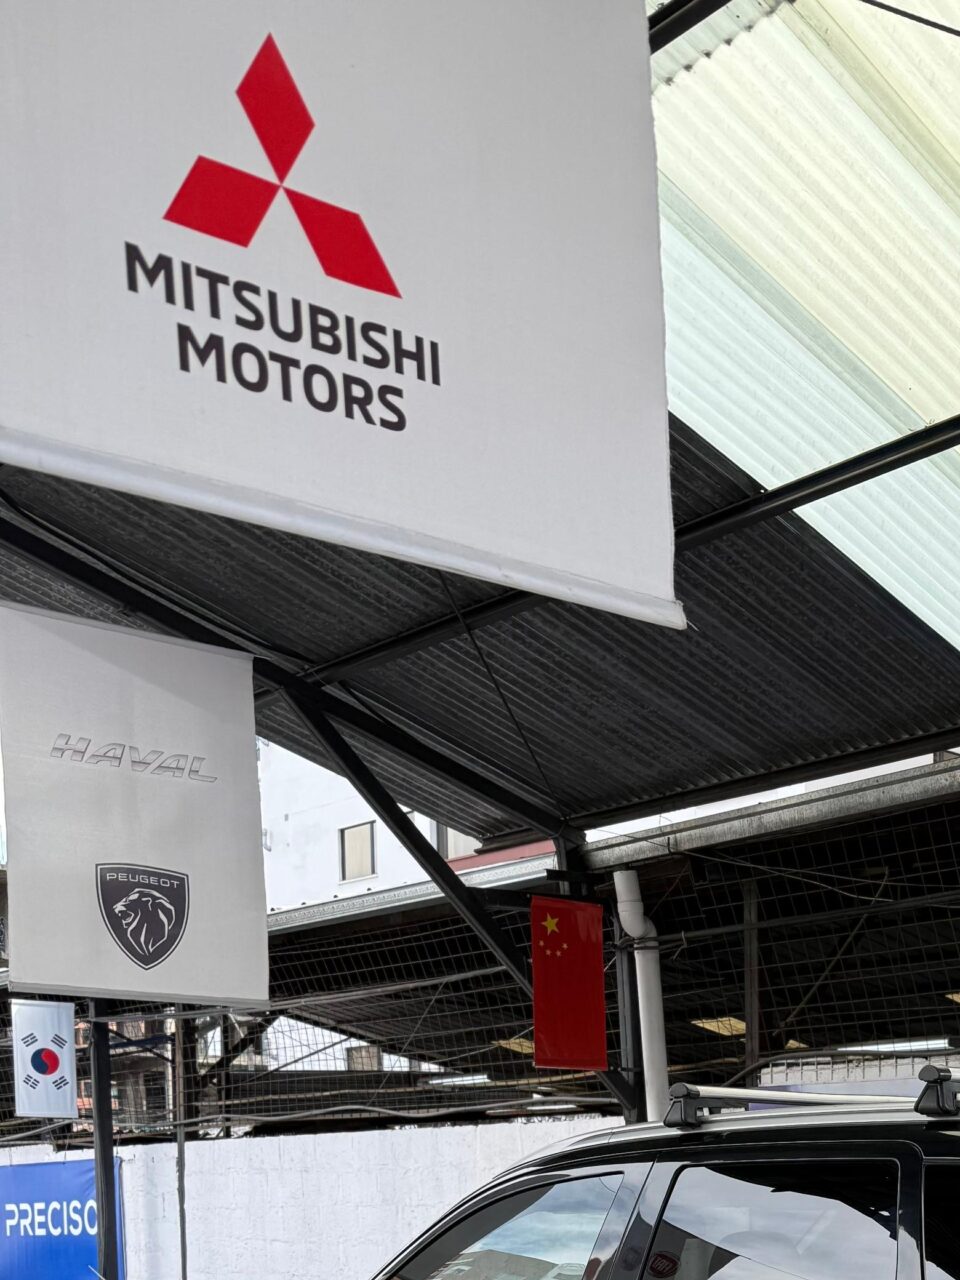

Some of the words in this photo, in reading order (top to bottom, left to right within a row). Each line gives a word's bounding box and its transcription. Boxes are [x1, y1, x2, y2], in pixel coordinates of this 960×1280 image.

[124, 240, 441, 387] MITSUBISHI
[177, 322, 407, 432] MOTORS
[50, 733, 218, 783] HAVAL
[106, 872, 180, 889] PEUGEOT
[5, 1199, 98, 1237] PRECISO
